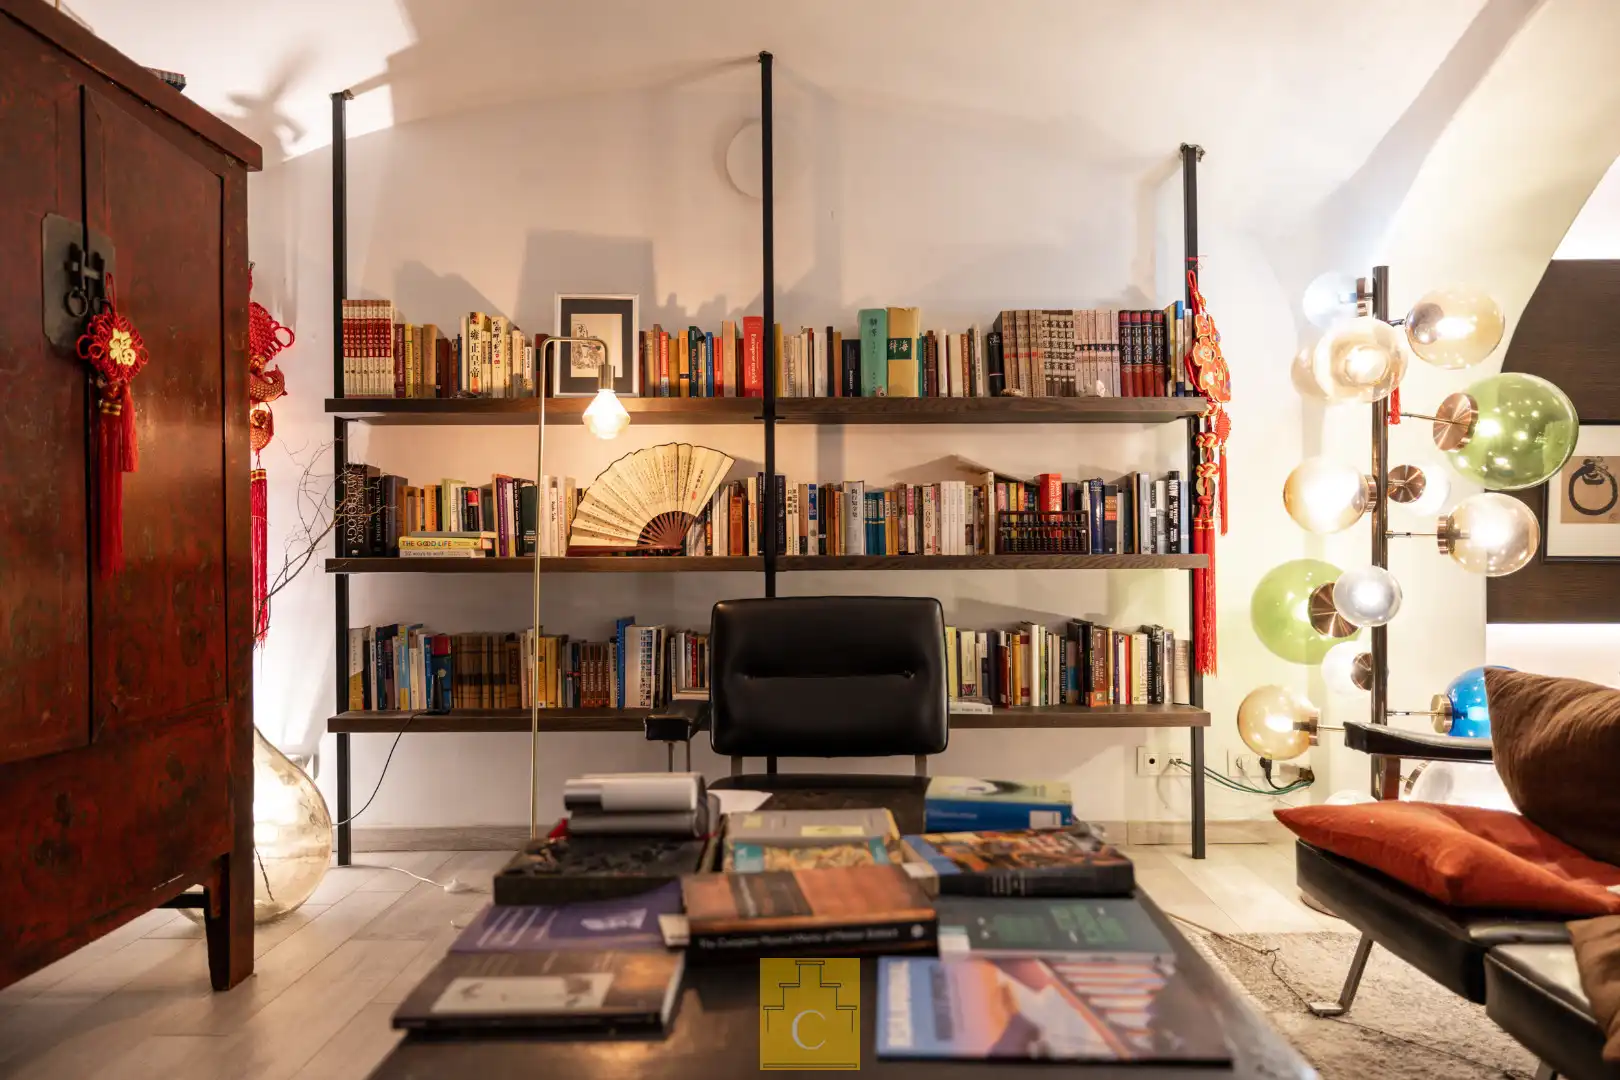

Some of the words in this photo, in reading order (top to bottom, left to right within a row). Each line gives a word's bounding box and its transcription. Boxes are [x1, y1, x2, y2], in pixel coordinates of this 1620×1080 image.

[109, 328, 136, 366] 福
[1121, 327, 1131, 364] 中国全史
[1132, 327, 1142, 364] 中国全史
[1143, 327, 1152, 364] 中国全史
[1169, 480, 1178, 496] NOW
[347, 473, 357, 544] MYTHOLOGY
[357, 534, 364, 544] OF
